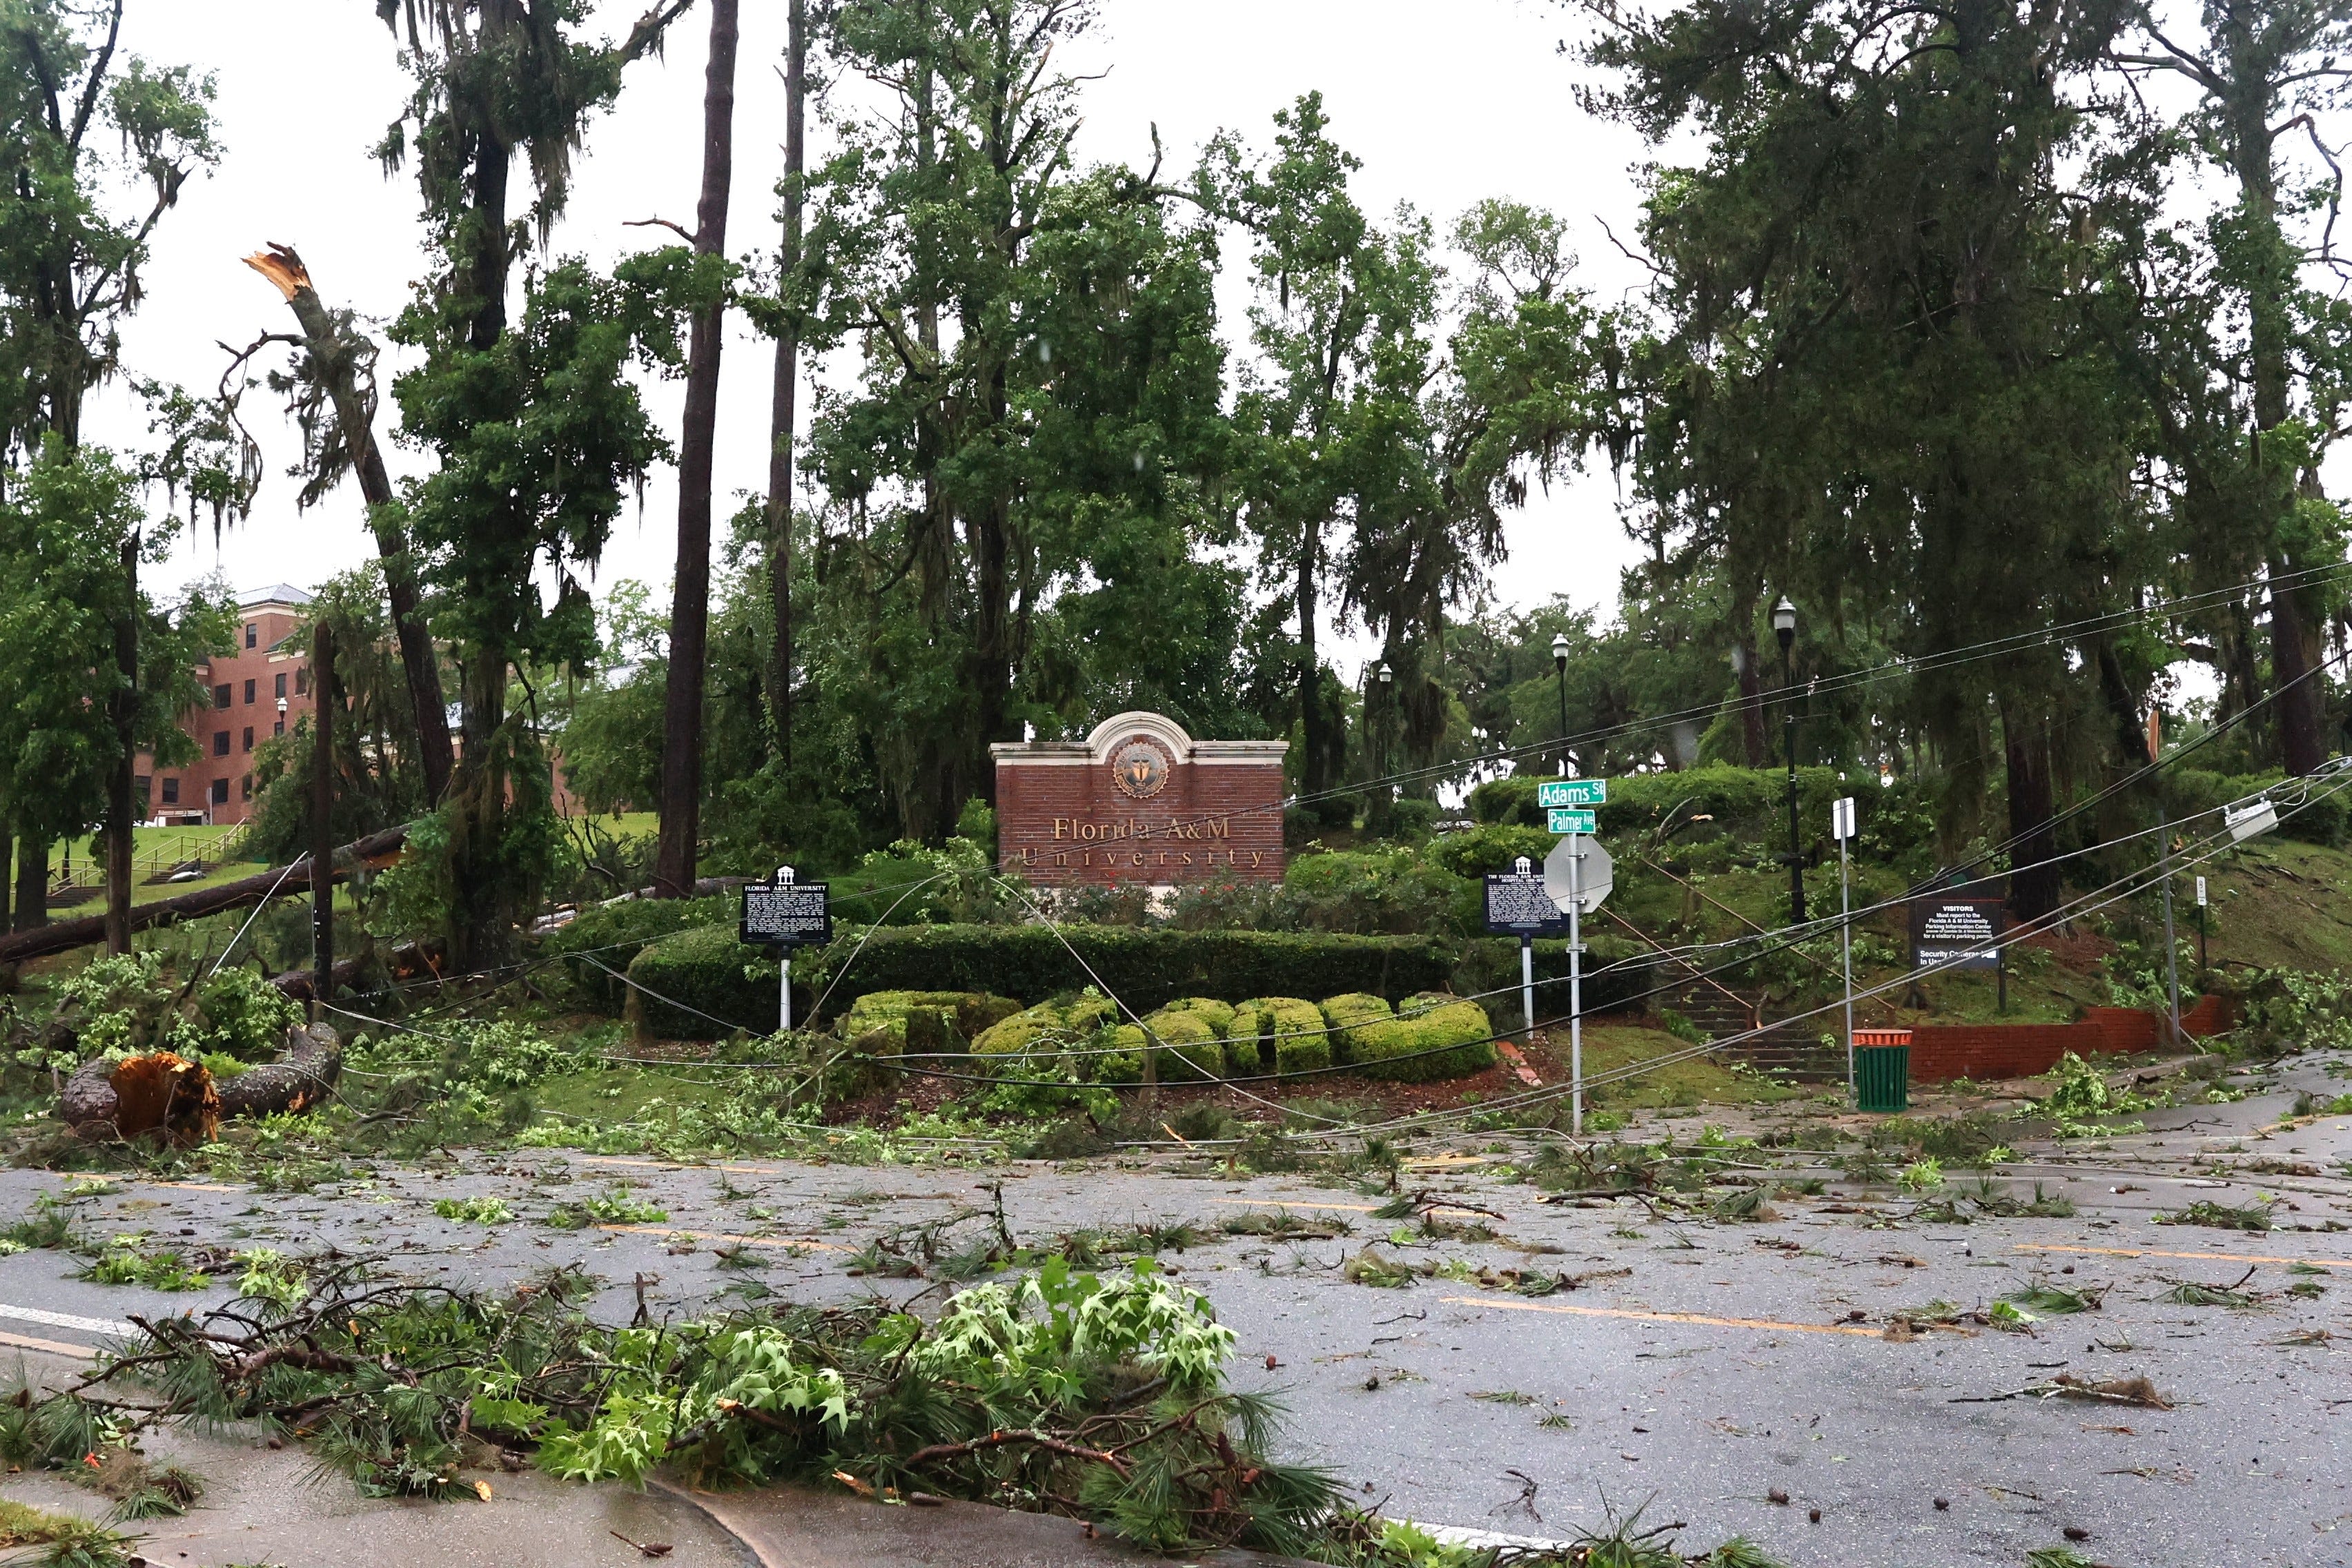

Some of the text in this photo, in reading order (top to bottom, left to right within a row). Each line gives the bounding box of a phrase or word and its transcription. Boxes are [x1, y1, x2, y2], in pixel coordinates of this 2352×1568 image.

[1542, 782, 1603, 804] Adams St
[1052, 818, 1231, 840] Florida A&M
[1550, 812, 1594, 830] Palmer Ave
[1022, 848, 1263, 868] University
[1920, 950, 1948, 959] Security
